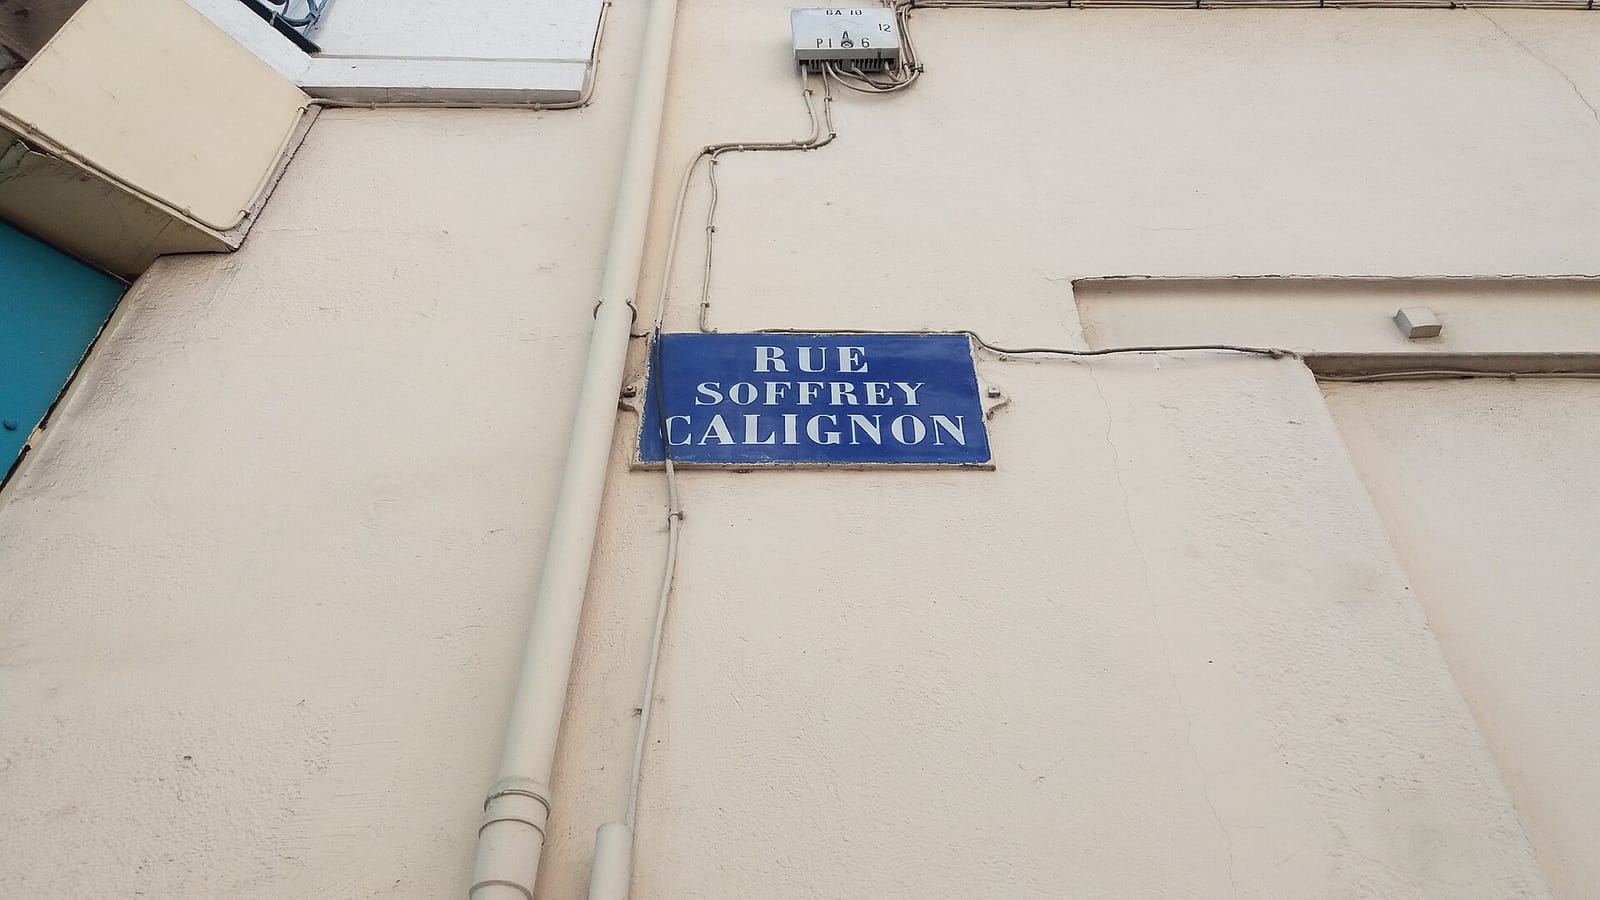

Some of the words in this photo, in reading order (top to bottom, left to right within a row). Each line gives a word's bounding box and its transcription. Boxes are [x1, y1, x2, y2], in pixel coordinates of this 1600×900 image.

[878, 23, 892, 33] 12
[753, 346, 869, 373] RUE
[695, 381, 925, 406] SOFFREY
[660, 414, 967, 446] CALIGNON
